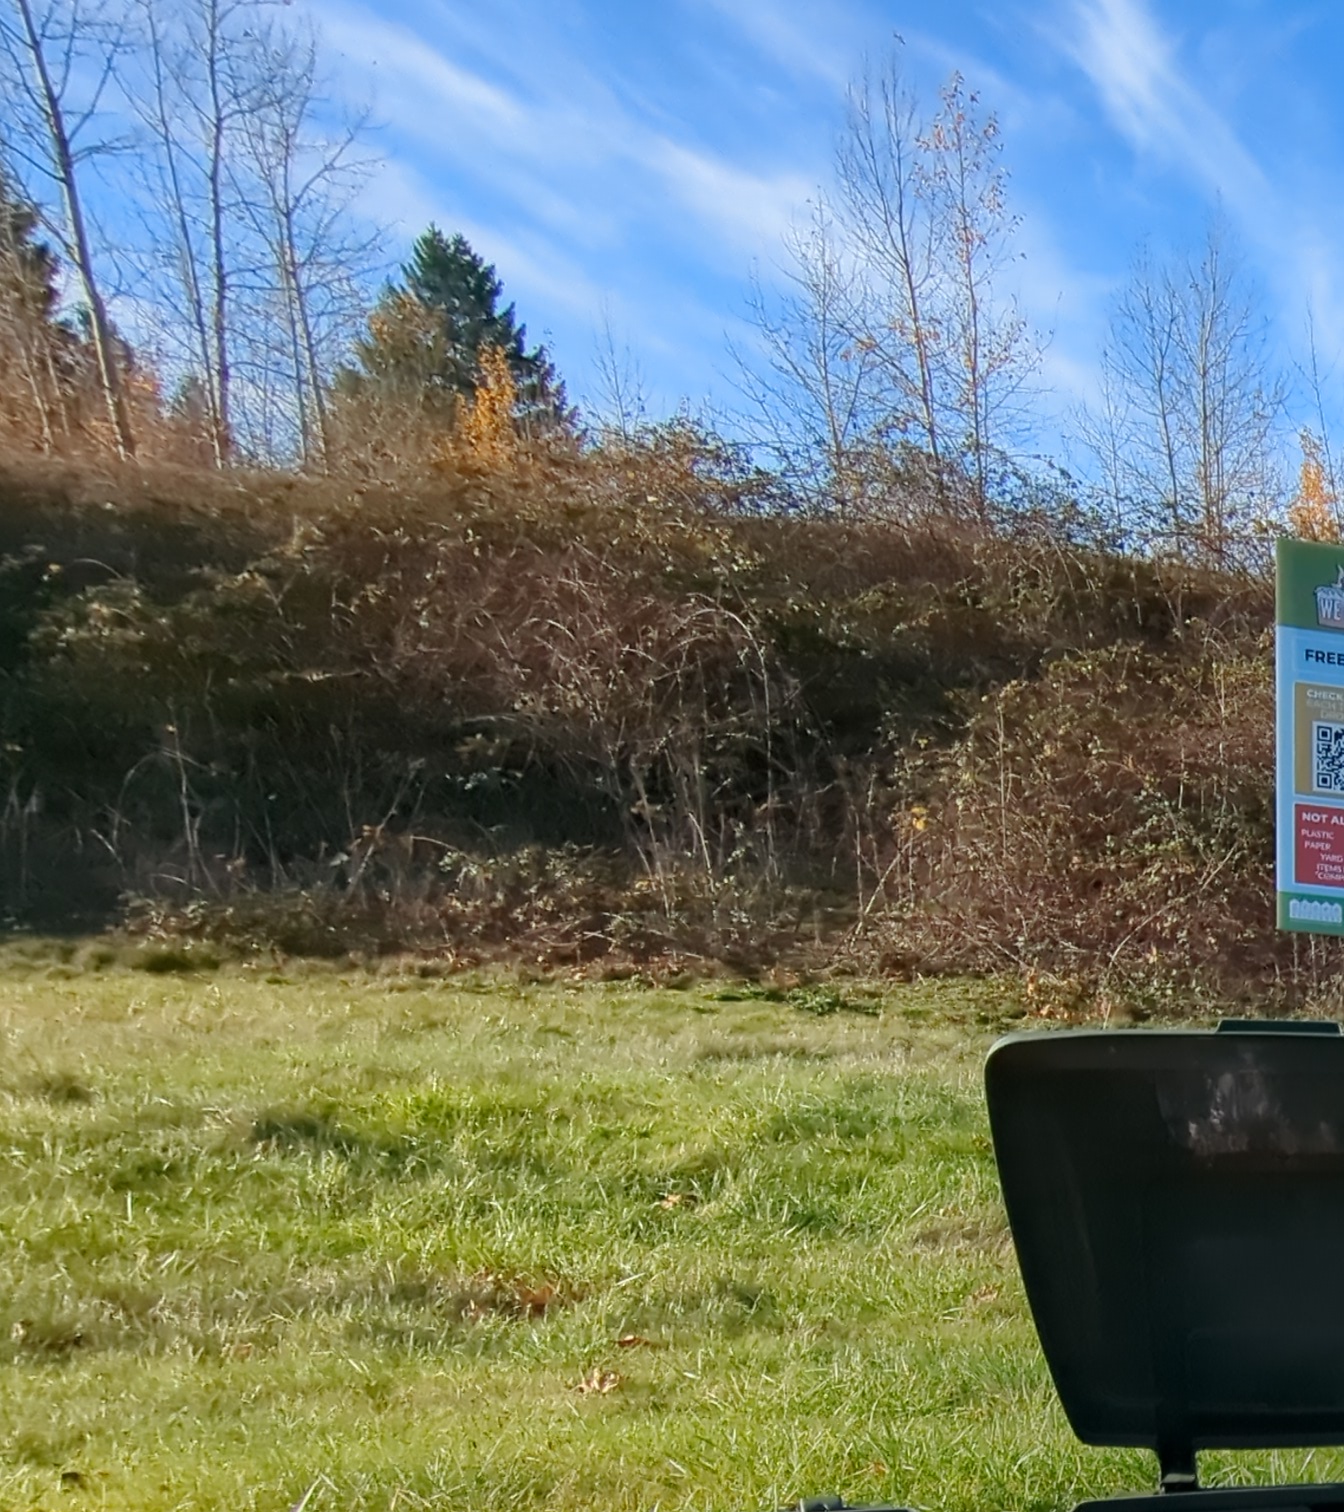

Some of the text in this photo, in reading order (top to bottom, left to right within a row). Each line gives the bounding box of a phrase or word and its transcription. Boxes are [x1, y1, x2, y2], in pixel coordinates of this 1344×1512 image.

[1320, 598, 1341, 621] WE
[1307, 689, 1343, 701] CHECK
[1302, 812, 1328, 824] NOT
[1301, 829, 1334, 840] PLASTIC
[1304, 841, 1331, 851] PAPER
[1320, 853, 1343, 863] YARD
[1317, 864, 1342, 873] ITEMS
